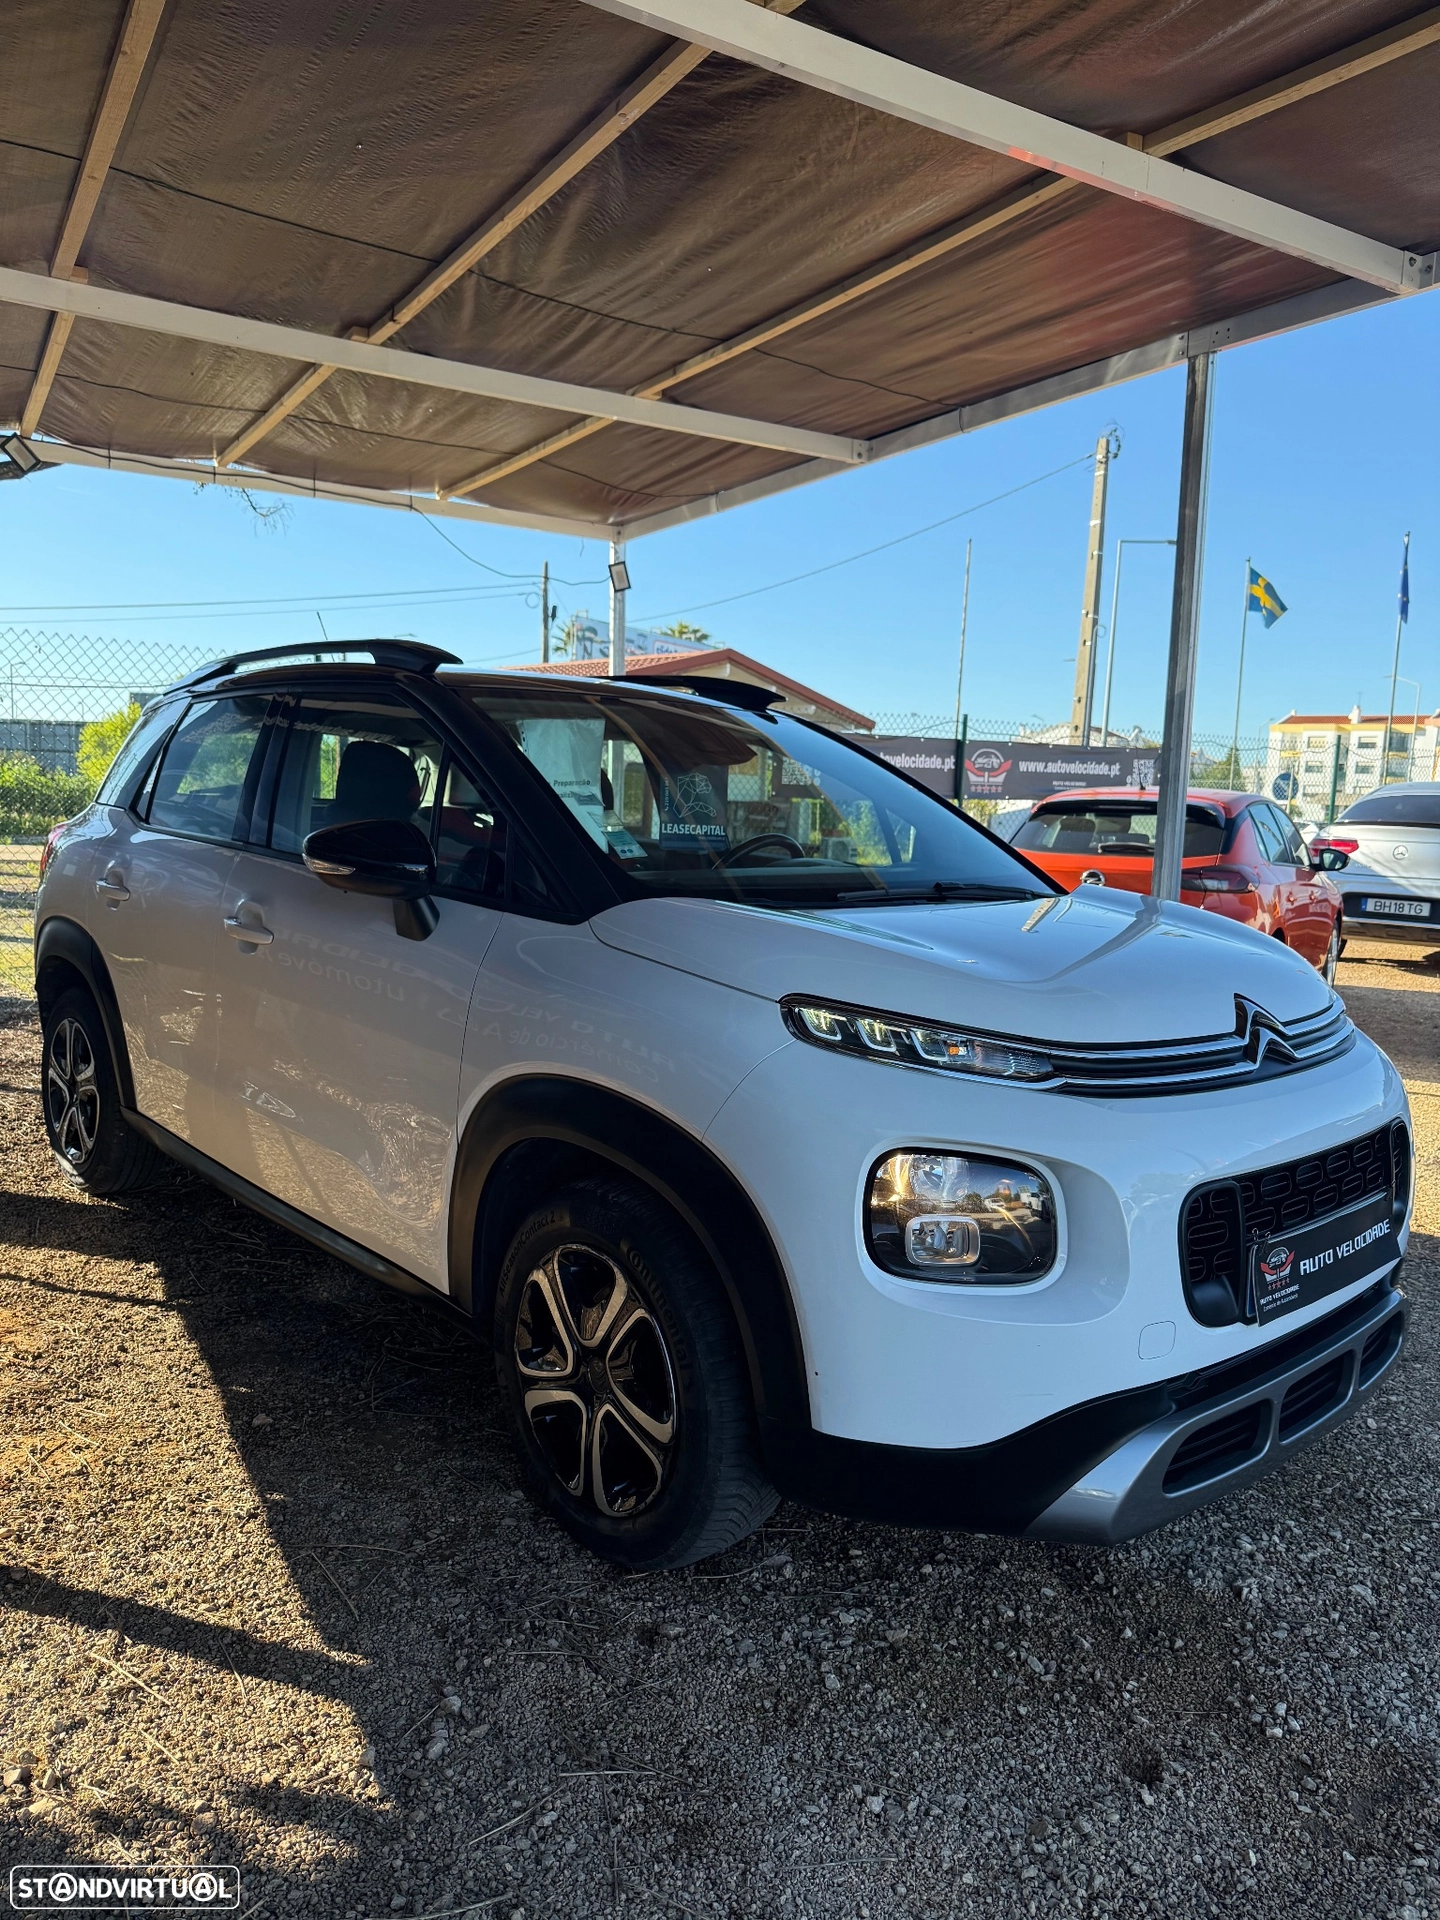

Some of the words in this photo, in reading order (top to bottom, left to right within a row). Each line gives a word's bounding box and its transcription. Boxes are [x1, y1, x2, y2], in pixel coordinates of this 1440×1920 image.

[1018, 759, 1121, 779] www.autovelocidade.pt
[661, 822, 726, 836] LEASECAPITAL
[1300, 1249, 1334, 1276] AUTO
[1336, 1218, 1391, 1260] VELOCIDADE
